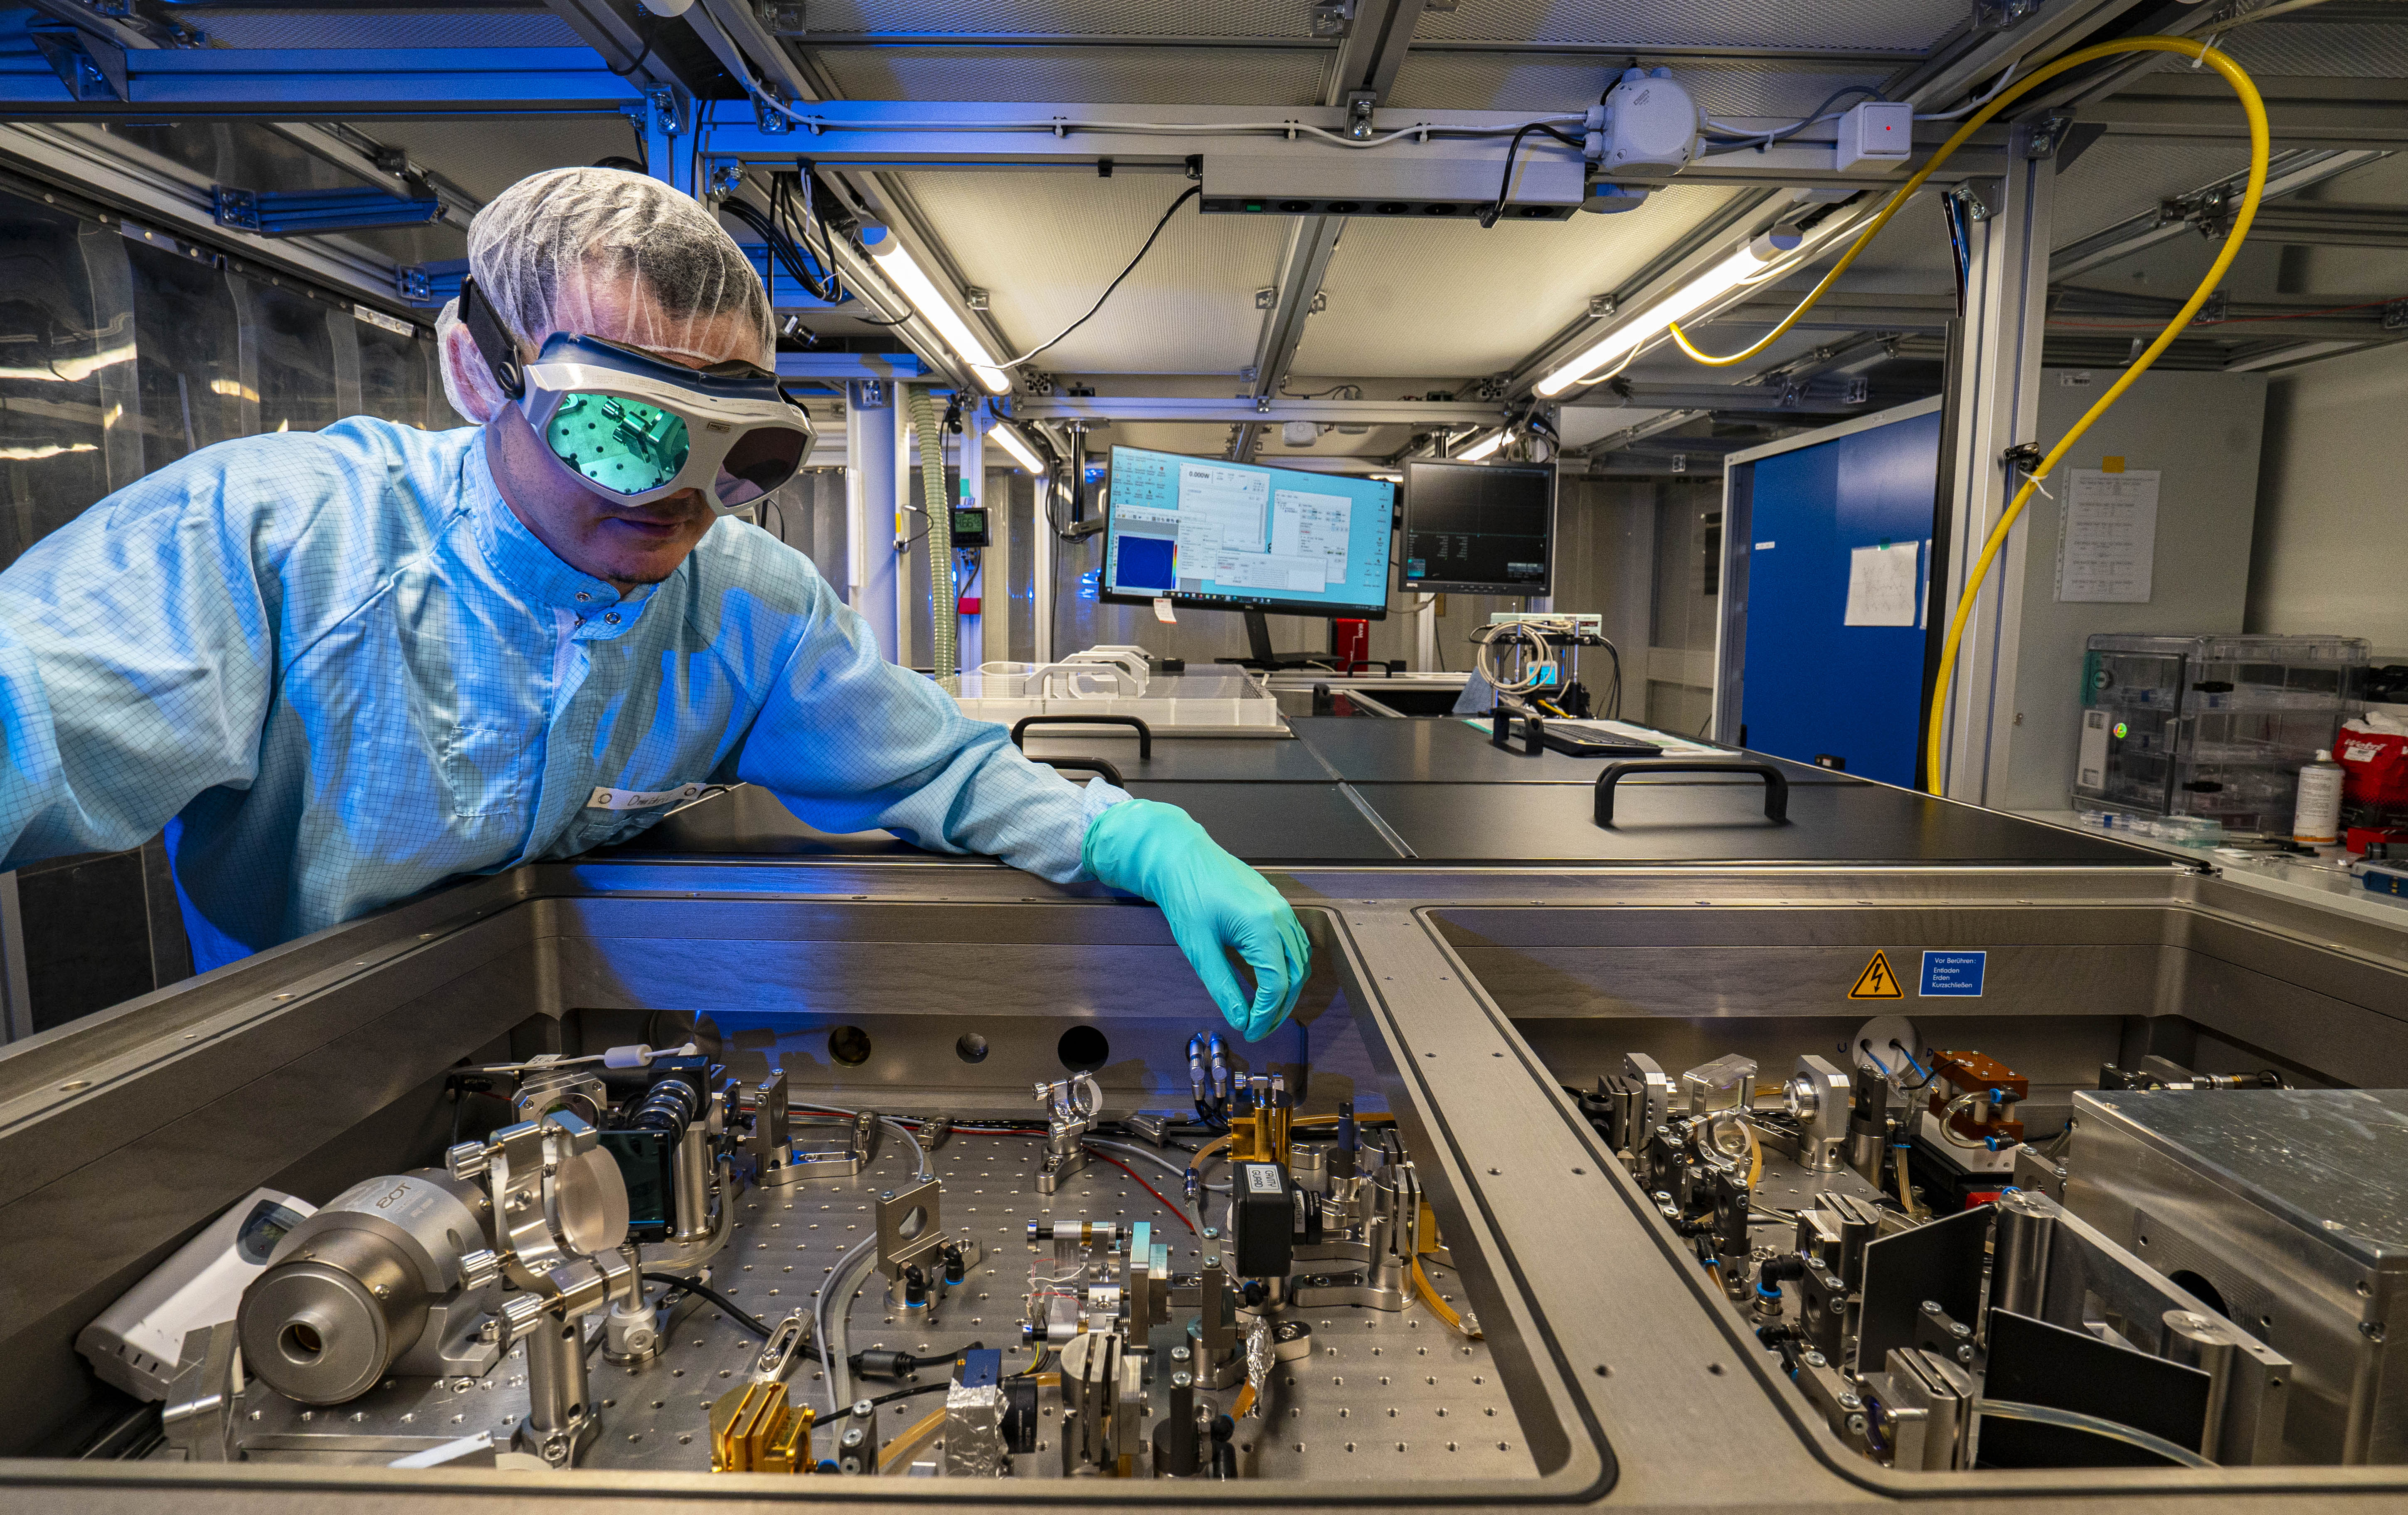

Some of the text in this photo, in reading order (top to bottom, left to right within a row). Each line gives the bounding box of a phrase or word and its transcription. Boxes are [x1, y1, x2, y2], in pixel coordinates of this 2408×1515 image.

[1837, 1042, 1847, 1053] U
[1926, 1048, 1933, 1058] D
[1252, 1170, 1263, 1188] GUARD
[1265, 1170, 1277, 1187] CAVITY
